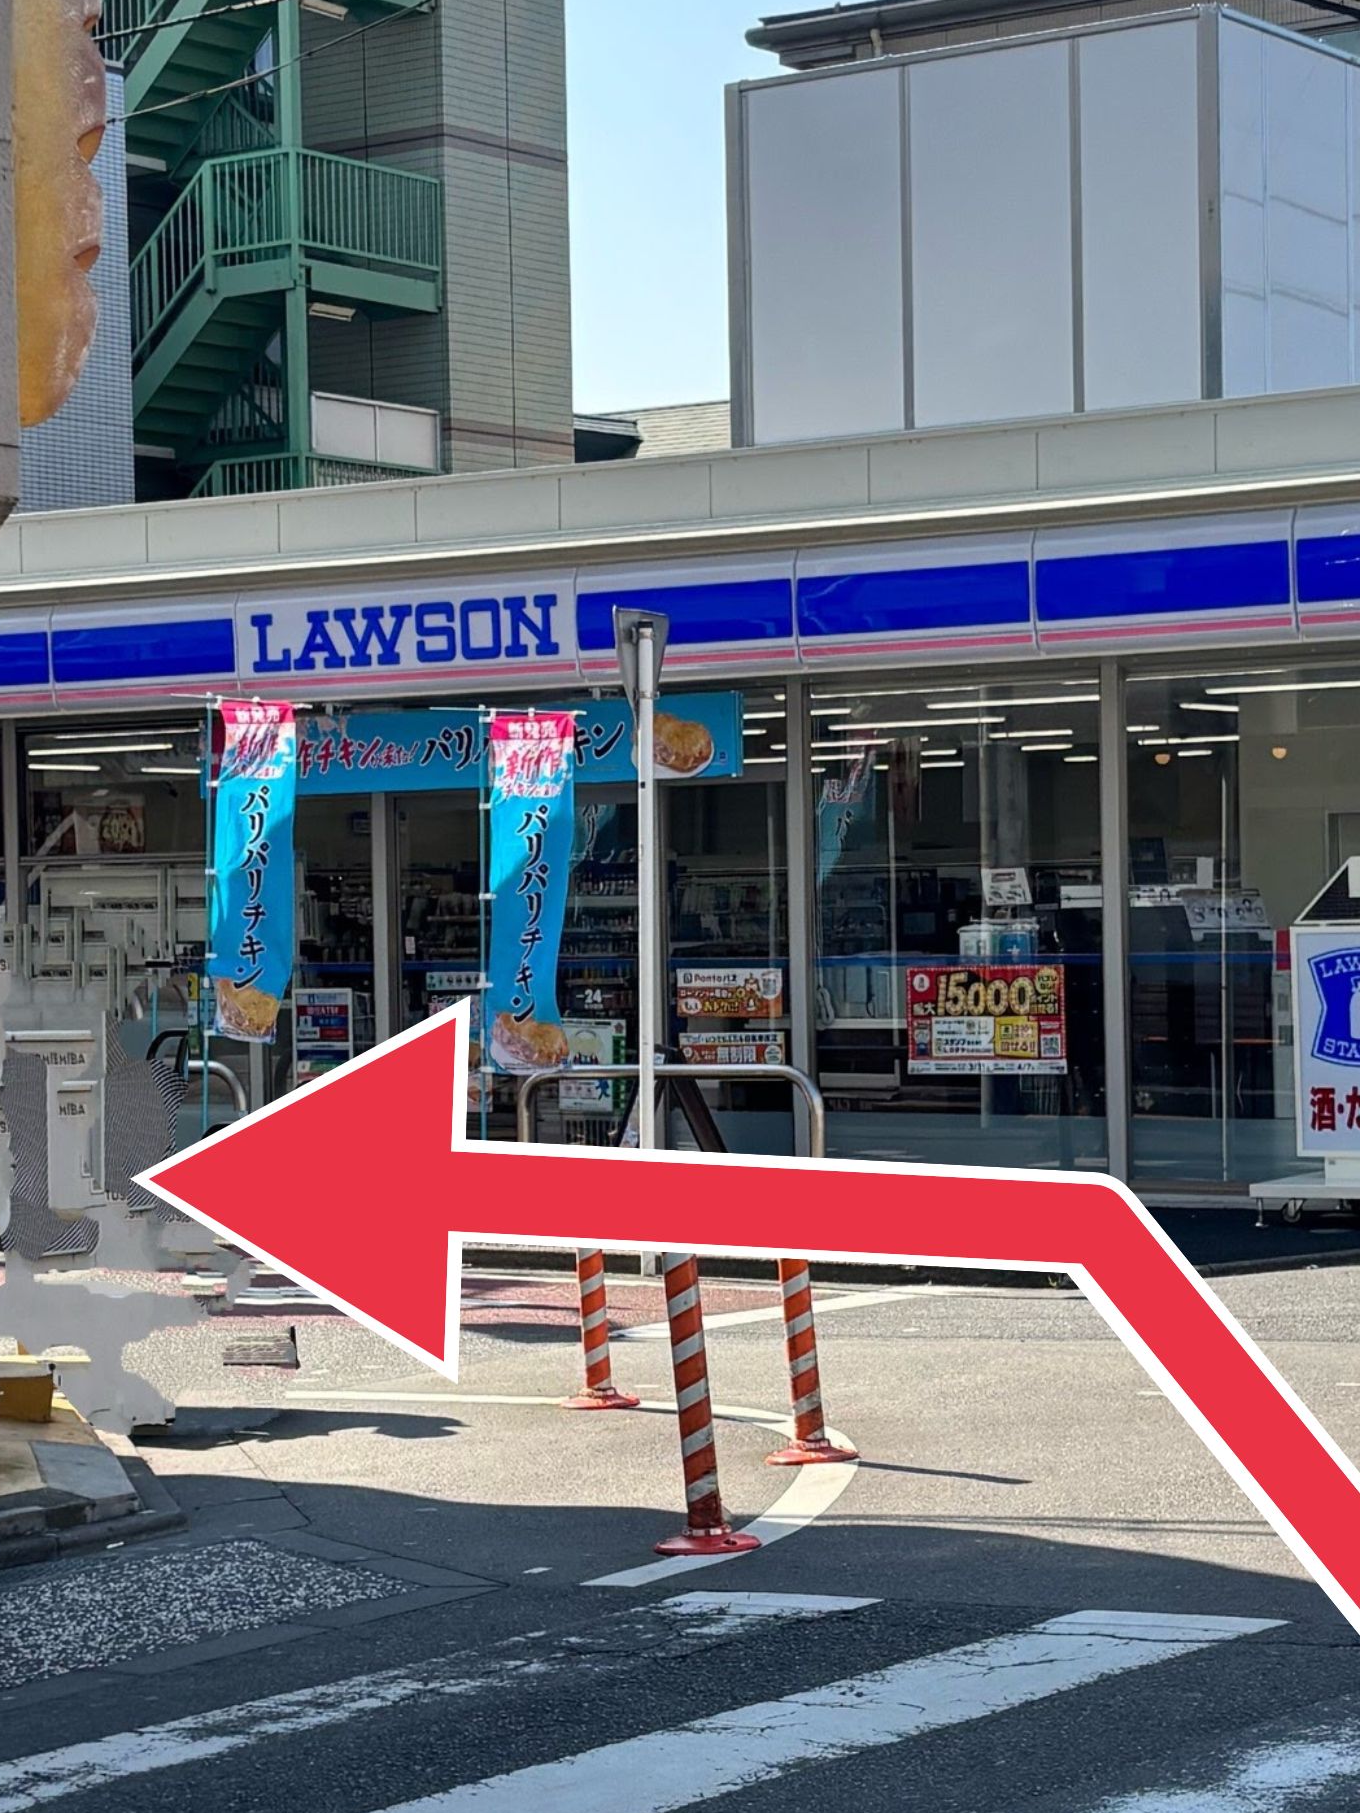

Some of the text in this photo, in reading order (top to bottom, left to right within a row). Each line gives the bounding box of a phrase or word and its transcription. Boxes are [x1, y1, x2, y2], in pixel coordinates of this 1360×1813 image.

[249, 593, 559, 674] LAWSON
[233, 785, 271, 989] パリパリチキン
[511, 804, 549, 1023] パリパリチキン
